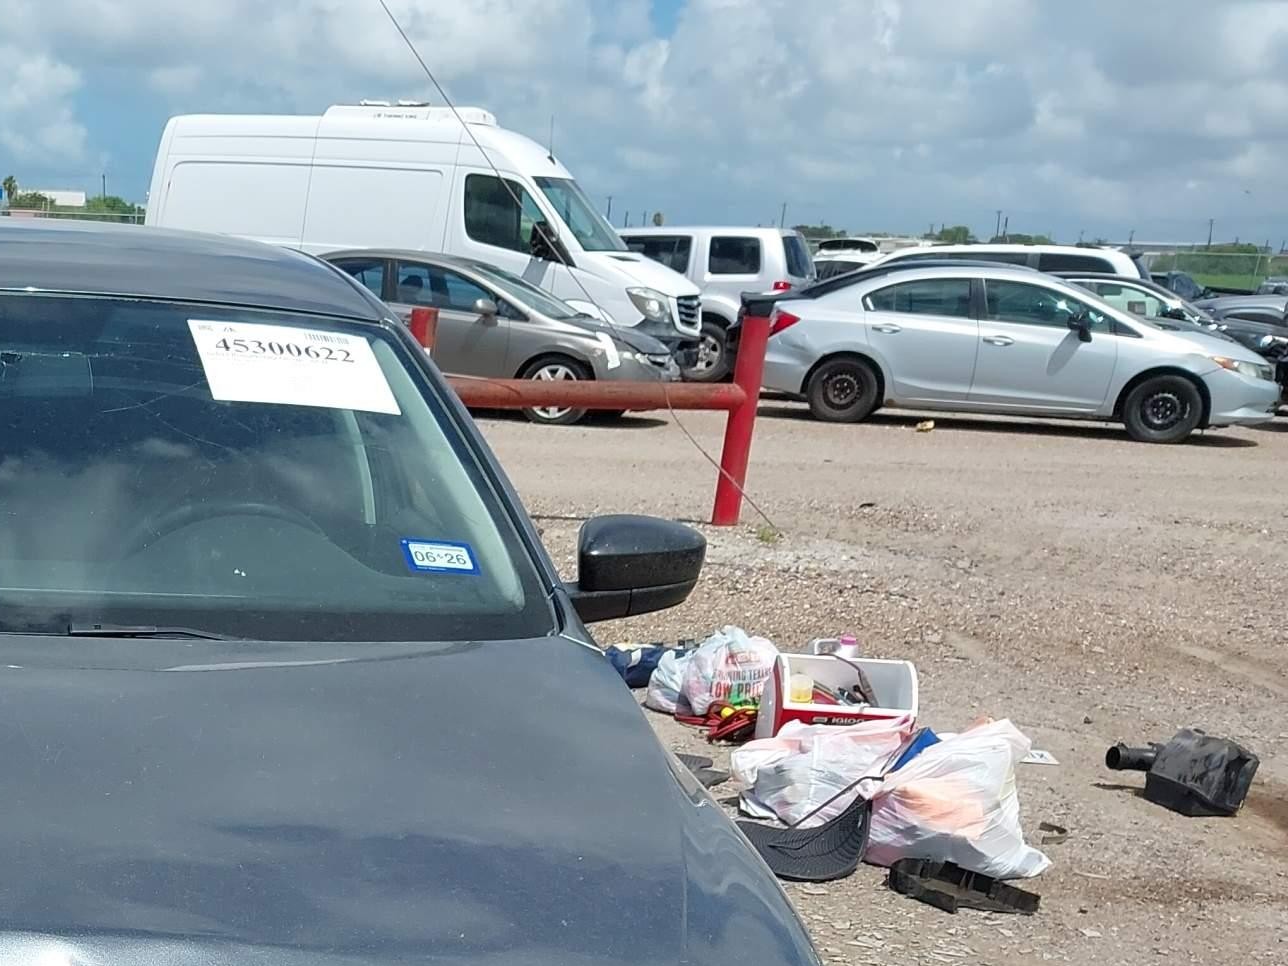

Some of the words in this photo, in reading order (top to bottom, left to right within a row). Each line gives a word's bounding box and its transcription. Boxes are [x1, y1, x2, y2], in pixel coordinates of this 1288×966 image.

[216, 337, 356, 364] 45300622
[414, 550, 437, 563] 06
[444, 553, 467, 566] 26
[710, 681, 733, 698] LOW
